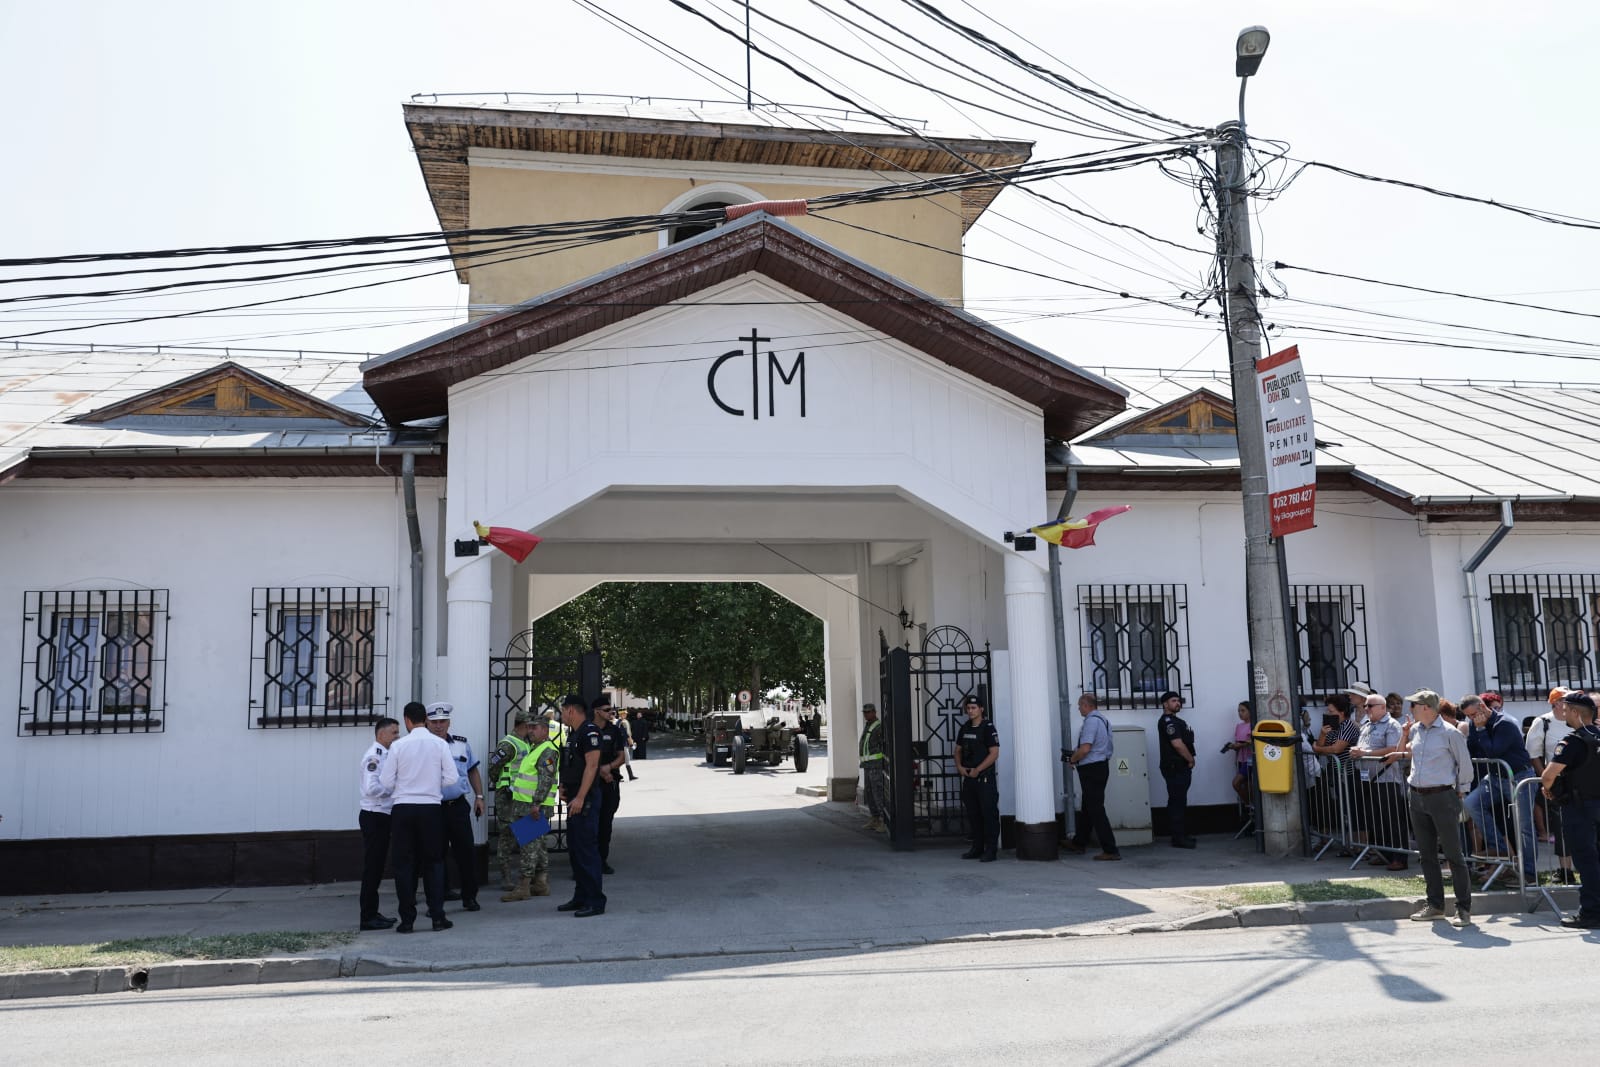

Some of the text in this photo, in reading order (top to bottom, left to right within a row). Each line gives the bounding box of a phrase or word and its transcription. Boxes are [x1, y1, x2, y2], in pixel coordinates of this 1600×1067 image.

[1267, 371, 1302, 392] PUBLICITATE
[1268, 415, 1306, 433] PUBLICITATE
[1270, 432, 1308, 450] PENTRU
[1273, 450, 1309, 467] COMPANIA TA
[1301, 490, 1312, 502] 427
